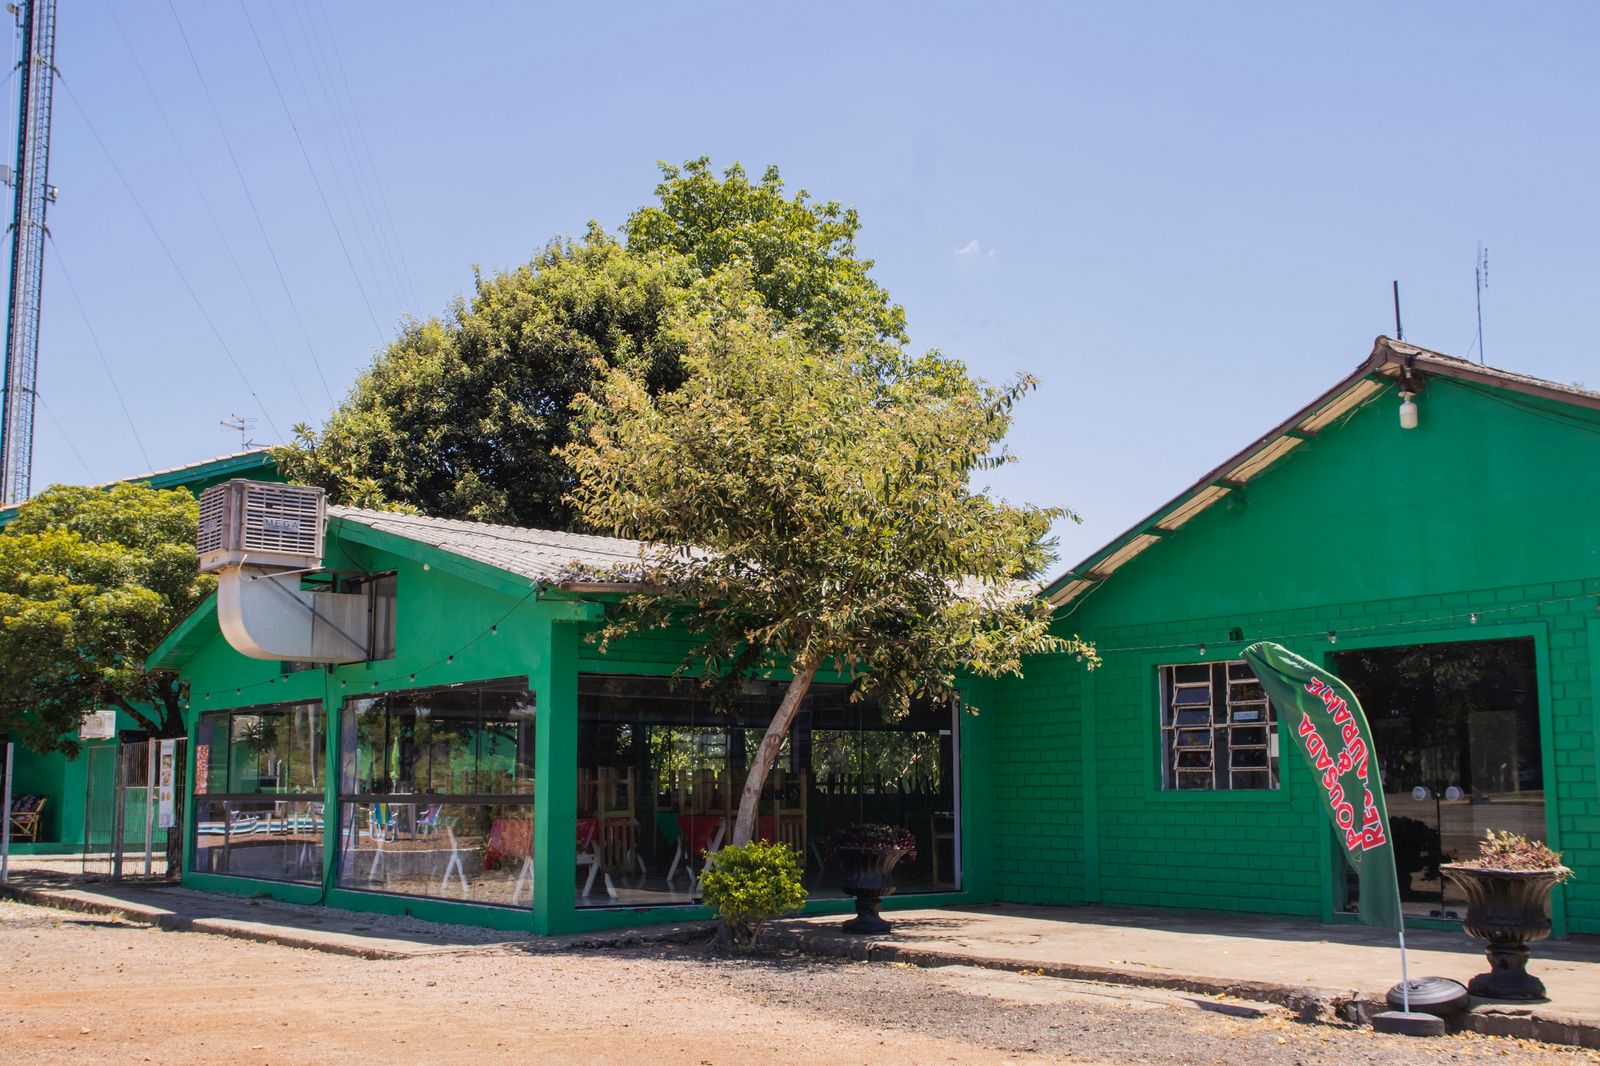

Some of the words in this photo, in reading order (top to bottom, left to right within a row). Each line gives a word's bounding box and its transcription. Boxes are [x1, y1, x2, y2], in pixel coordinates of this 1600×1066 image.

[265, 518, 298, 529] MEGA
[1298, 711, 1364, 851] POUSADA
[1304, 676, 1387, 852] REAURANE
[1337, 747, 1353, 777] &
